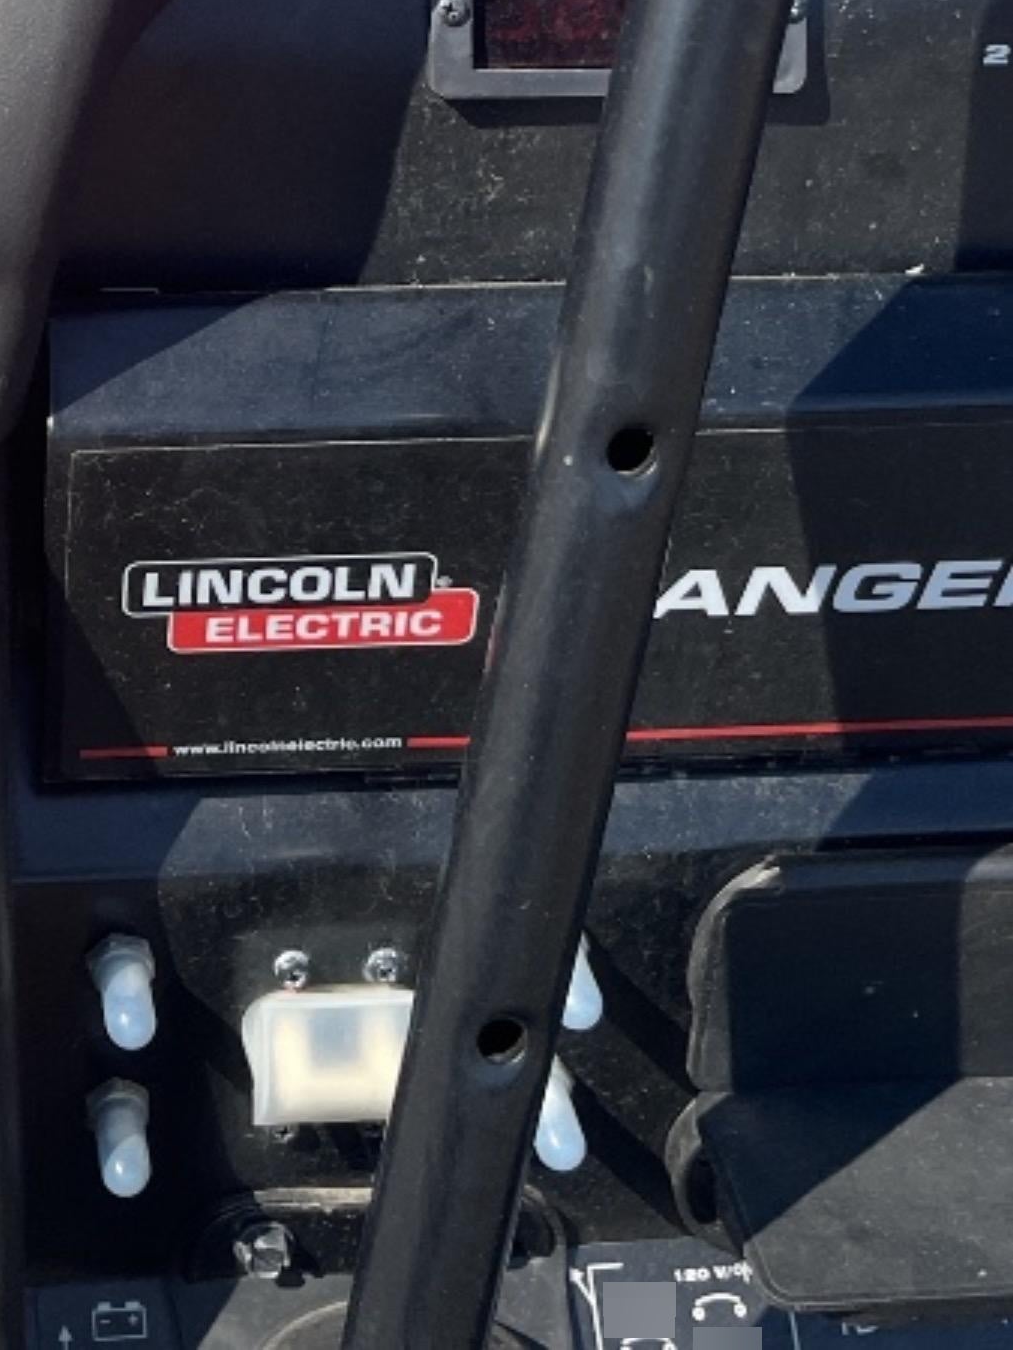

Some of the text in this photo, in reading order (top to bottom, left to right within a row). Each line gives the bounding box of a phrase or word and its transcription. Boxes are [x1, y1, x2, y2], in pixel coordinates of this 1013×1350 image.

[142, 563, 416, 607] LINCOLN
[652, 559, 1013, 619] ANGE
[204, 610, 443, 643] ELECTRIC
